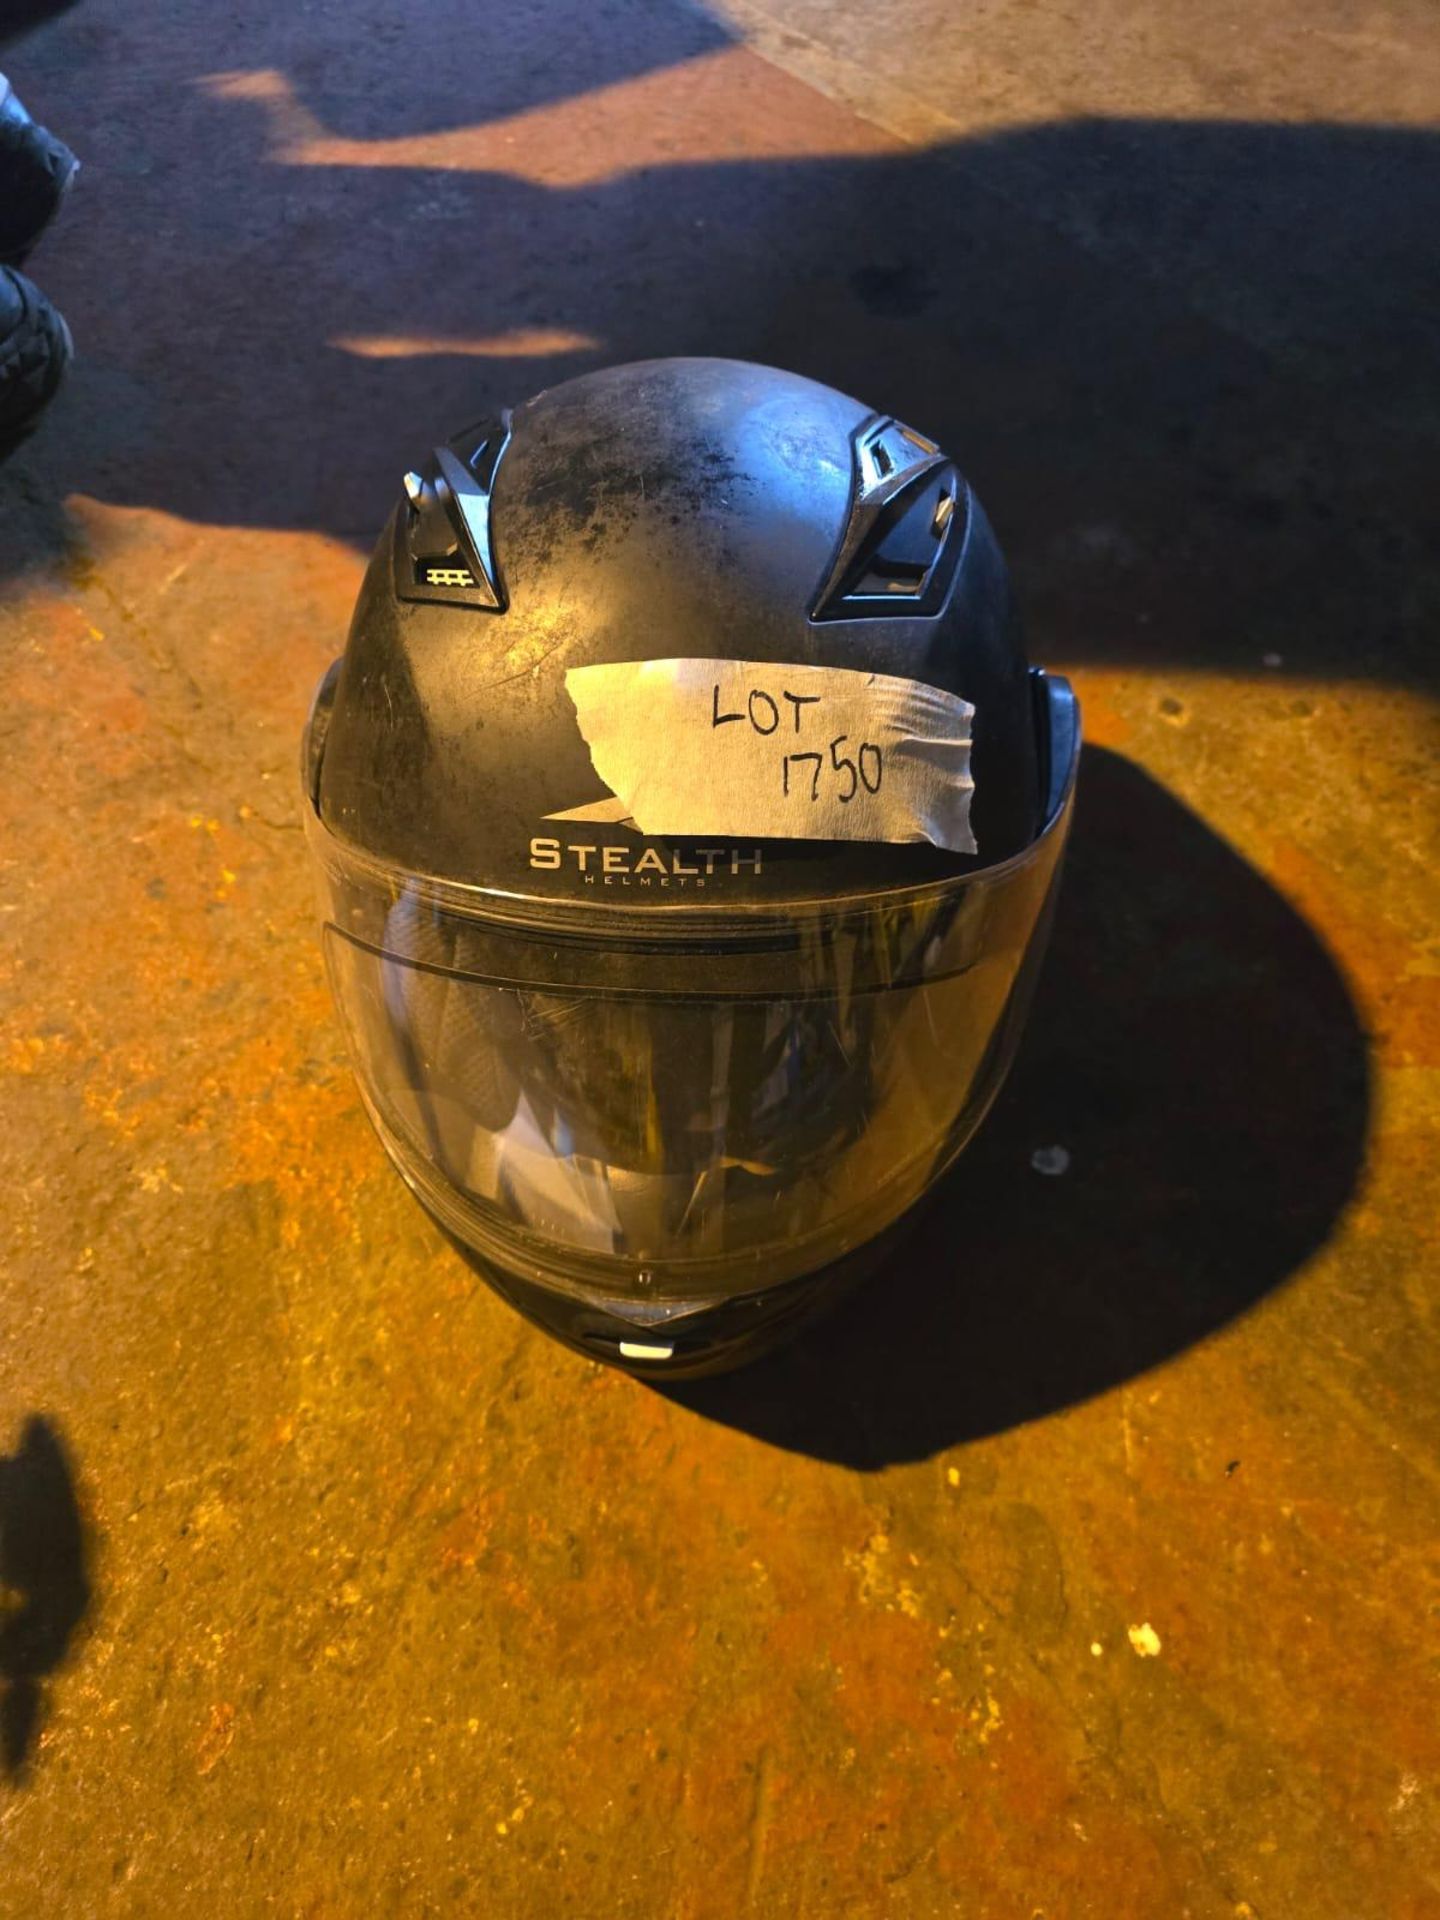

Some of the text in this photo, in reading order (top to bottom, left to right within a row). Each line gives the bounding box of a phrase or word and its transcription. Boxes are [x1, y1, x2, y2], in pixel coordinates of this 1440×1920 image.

[712, 684, 821, 735] LOT
[782, 735, 882, 803] 1750
[529, 837, 762, 875] STEALTH
[584, 874, 706, 888] HELMETS
